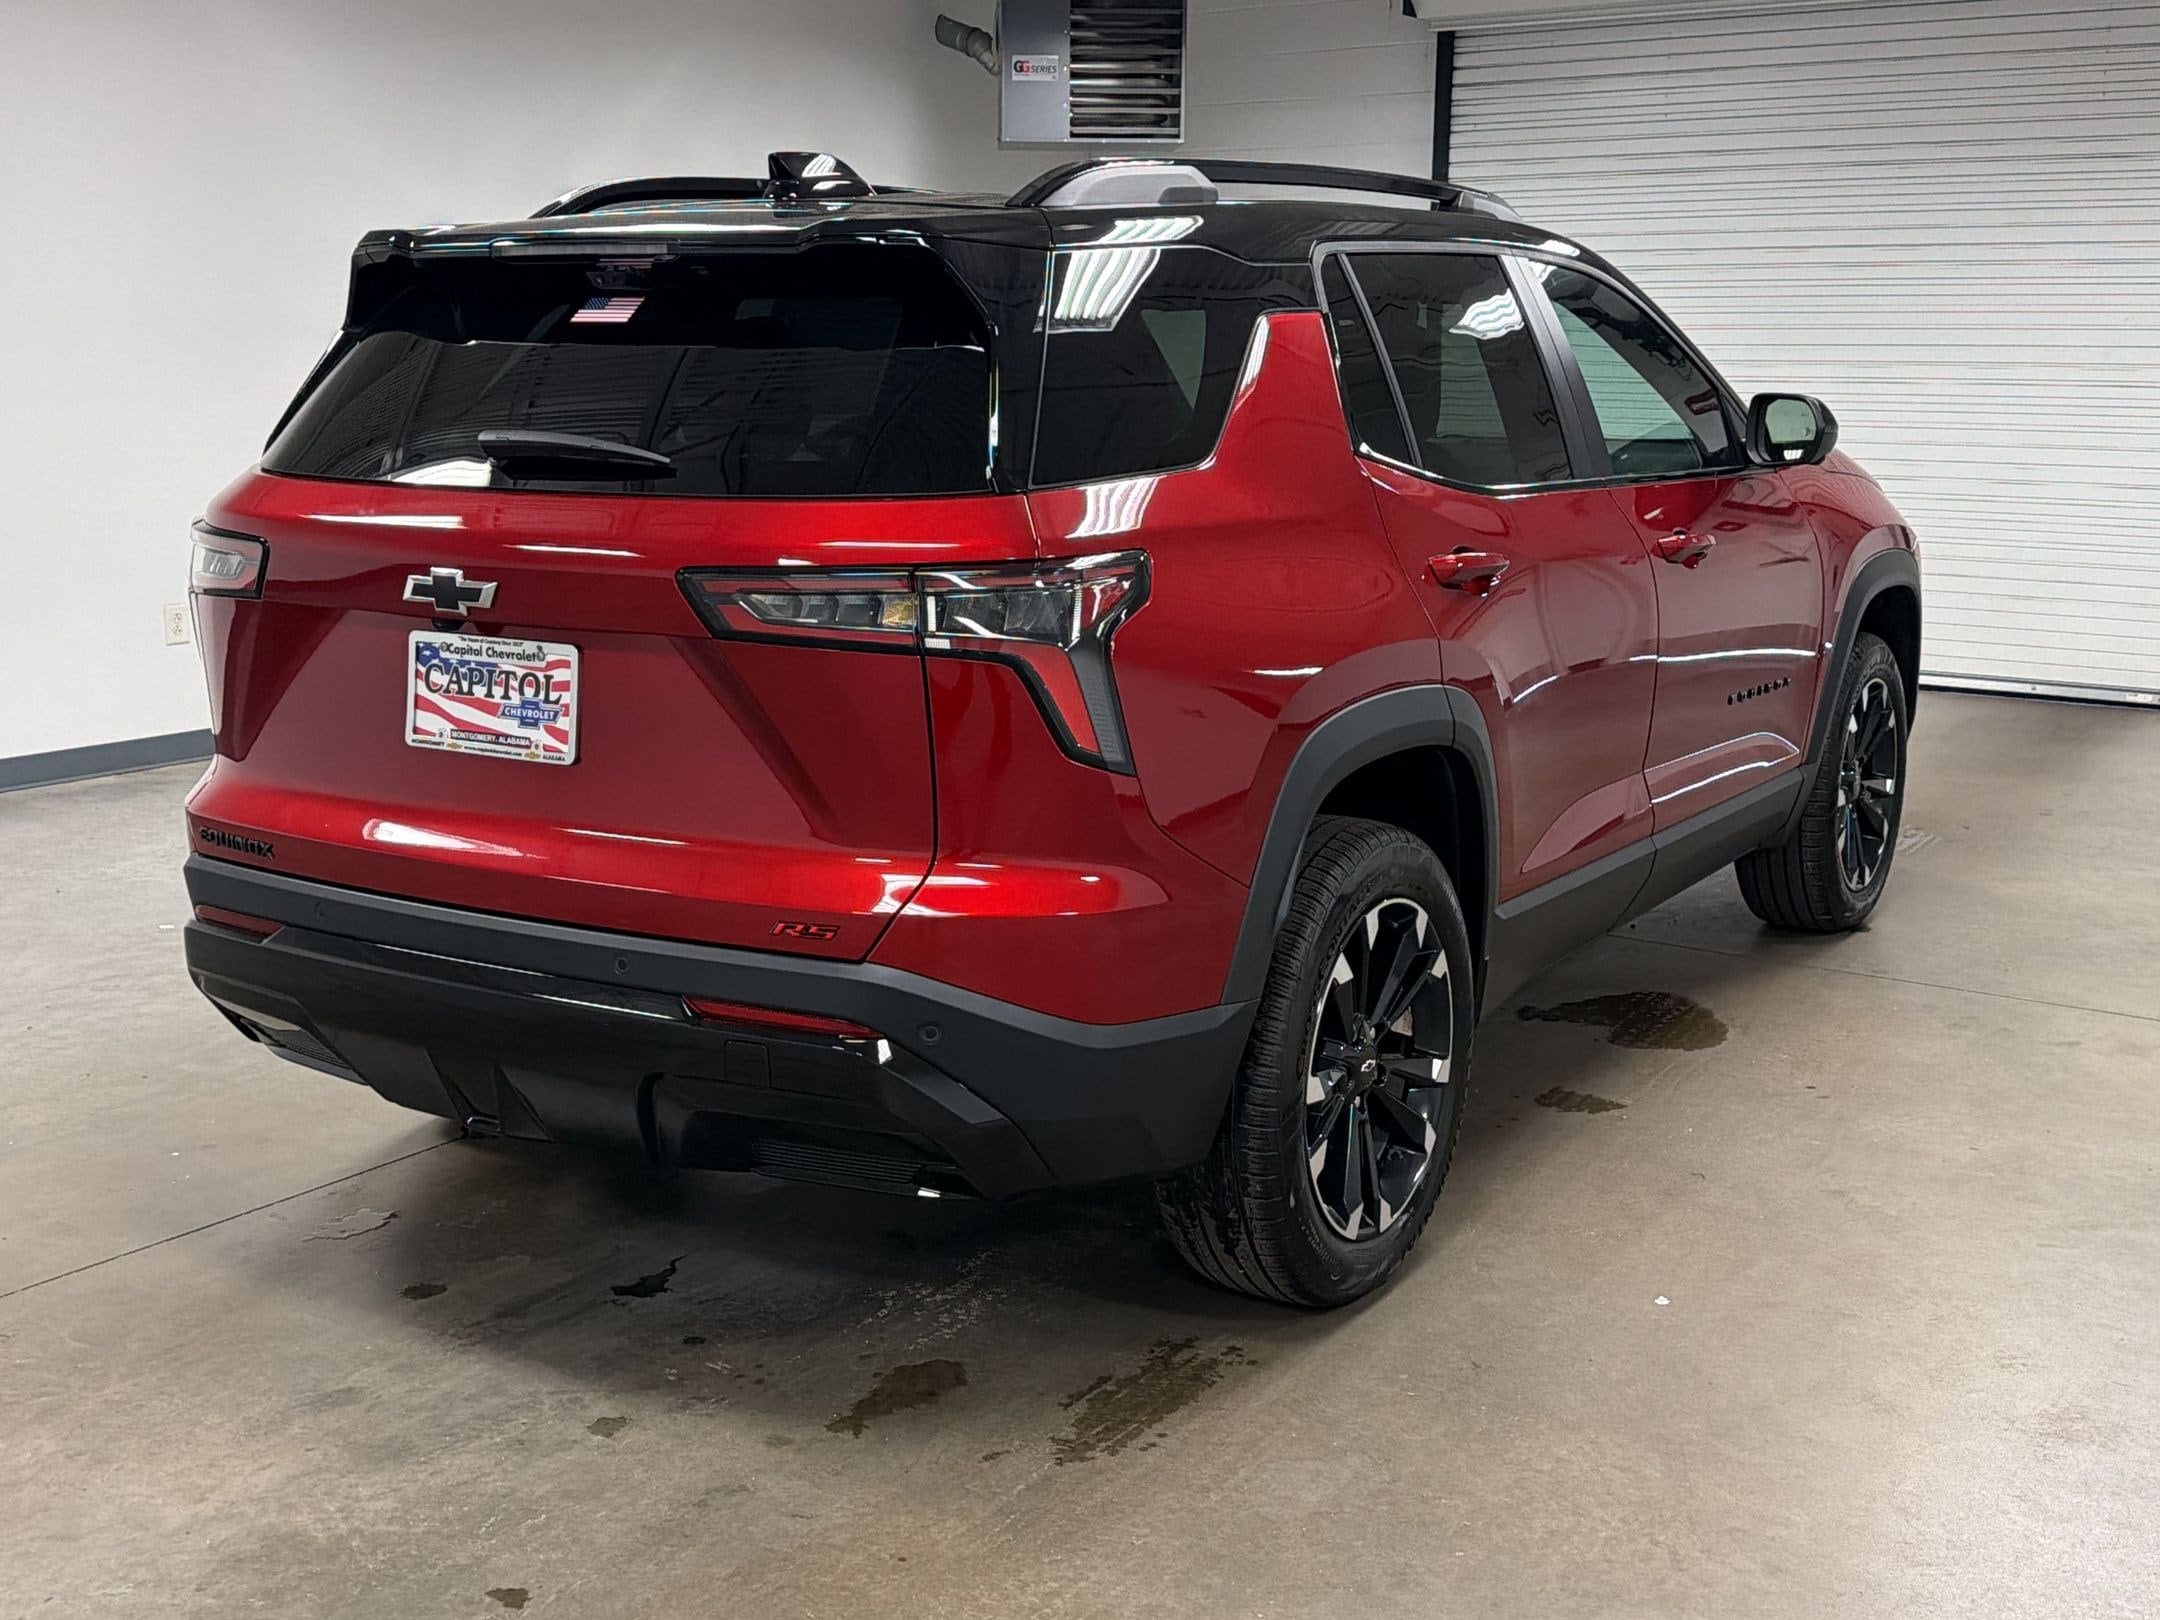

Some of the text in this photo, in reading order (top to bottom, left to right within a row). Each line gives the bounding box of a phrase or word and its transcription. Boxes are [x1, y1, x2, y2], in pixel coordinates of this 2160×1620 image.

[1030, 65, 1057, 73] SERIES
[447, 642, 536, 662] Capitol Chevrolet
[424, 663, 563, 705] CAPITOL
[504, 706, 555, 720] CHEVROLET
[498, 735, 531, 746] ALABAMA
[769, 920, 841, 941] RS
